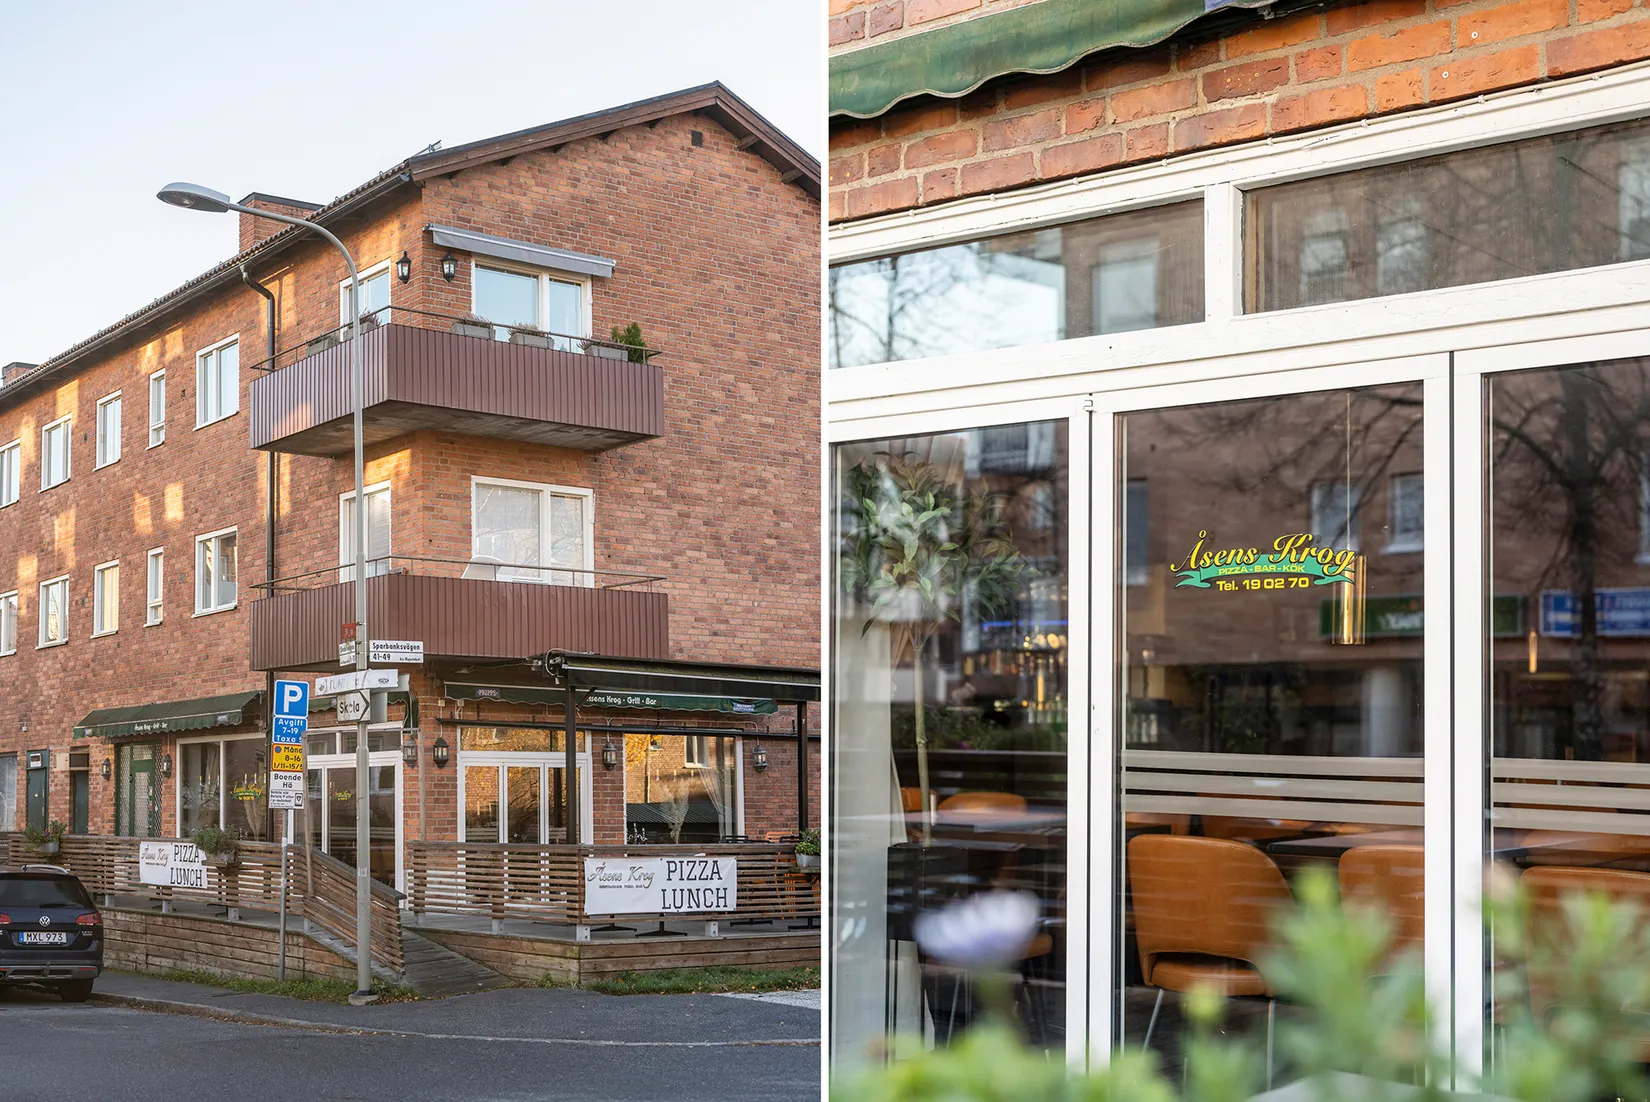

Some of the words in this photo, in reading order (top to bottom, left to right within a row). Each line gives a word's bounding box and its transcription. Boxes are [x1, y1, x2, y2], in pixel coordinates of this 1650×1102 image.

[1170, 530, 1261, 572] Åsens
[1268, 534, 1357, 576] Krog
[1218, 566, 1247, 576] PIZZA
[1254, 565, 1277, 573] BAR
[1282, 563, 1305, 573] KÖK
[1216, 580, 1239, 591] Tel.
[1243, 579, 1261, 590] 19
[1263, 578, 1285, 589] 02
[1288, 577, 1310, 588] 70
[372, 642, 421, 651] Sparbanksvägen
[283, 684, 303, 713] P
[606, 695, 621, 705] Krog
[278, 718, 303, 727] Avgift
[282, 727, 299, 735] 7-19
[276, 734, 296, 742] Taxa
[274, 773, 302, 781] Boende
[173, 845, 200, 863] PIZZA
[170, 867, 203, 887] LUNCH
[587, 861, 622, 882] Åsens
[628, 866, 656, 889] Krog
[666, 860, 723, 881] PIZZA
[661, 887, 728, 910] LUNCH
[26, 932, 43, 942] MXL
[46, 932, 64, 942] 973
